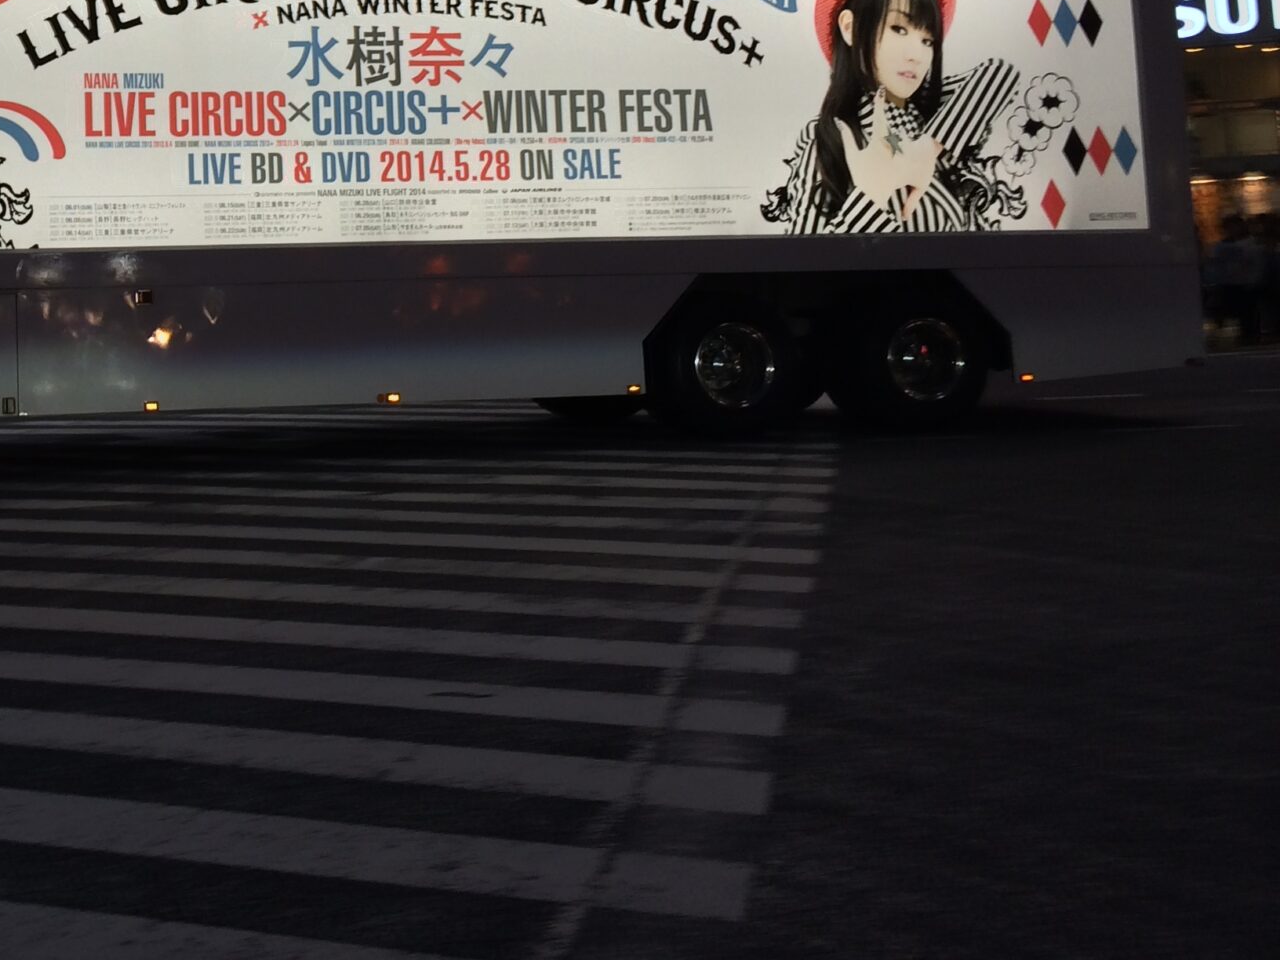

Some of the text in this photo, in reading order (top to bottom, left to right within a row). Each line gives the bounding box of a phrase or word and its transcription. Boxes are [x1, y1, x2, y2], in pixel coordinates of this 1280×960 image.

[287, 24, 516, 87] 水樹奈々
[83, 72, 164, 89] NANA MIZUKI
[84, 91, 157, 138] LIVE
[619, 88, 714, 133] FESTA
[187, 148, 622, 185] LIVE BD & DVD 2014.5.28 ON SALE
[317, 189, 337, 197] NANA
[339, 189, 365, 197] MIZUKI
[366, 189, 382, 197] LIVE
[383, 188, 408, 196] FLIGHT
[409, 188, 427, 196] 2014
